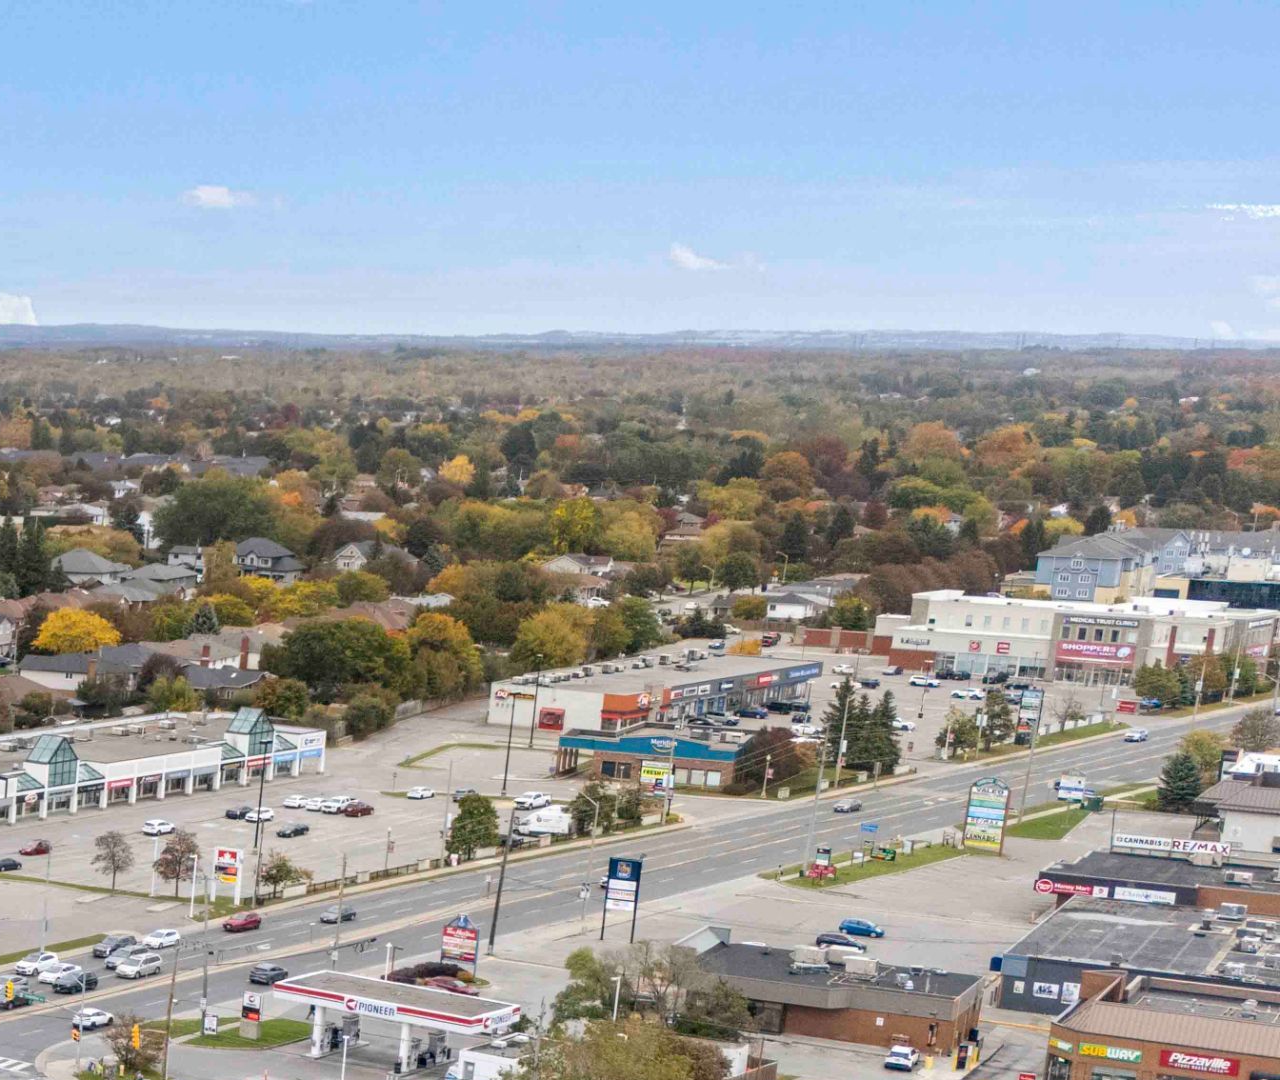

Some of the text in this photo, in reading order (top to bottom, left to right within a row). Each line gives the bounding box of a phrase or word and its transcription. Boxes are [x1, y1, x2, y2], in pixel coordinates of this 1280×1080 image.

[1070, 616, 1096, 624] MEDICAL
[1062, 643, 1117, 653] SHOPPERS
[965, 832, 996, 842] CANNABIS
[1124, 837, 1162, 847] CANNABIS
[1172, 840, 1230, 855] RE/MAX
[358, 1002, 395, 1017] PIONEER
[491, 1012, 512, 1026] PIONEER
[1081, 1044, 1138, 1061] SUBWAY
[1169, 1052, 1231, 1070] Pizzaville
